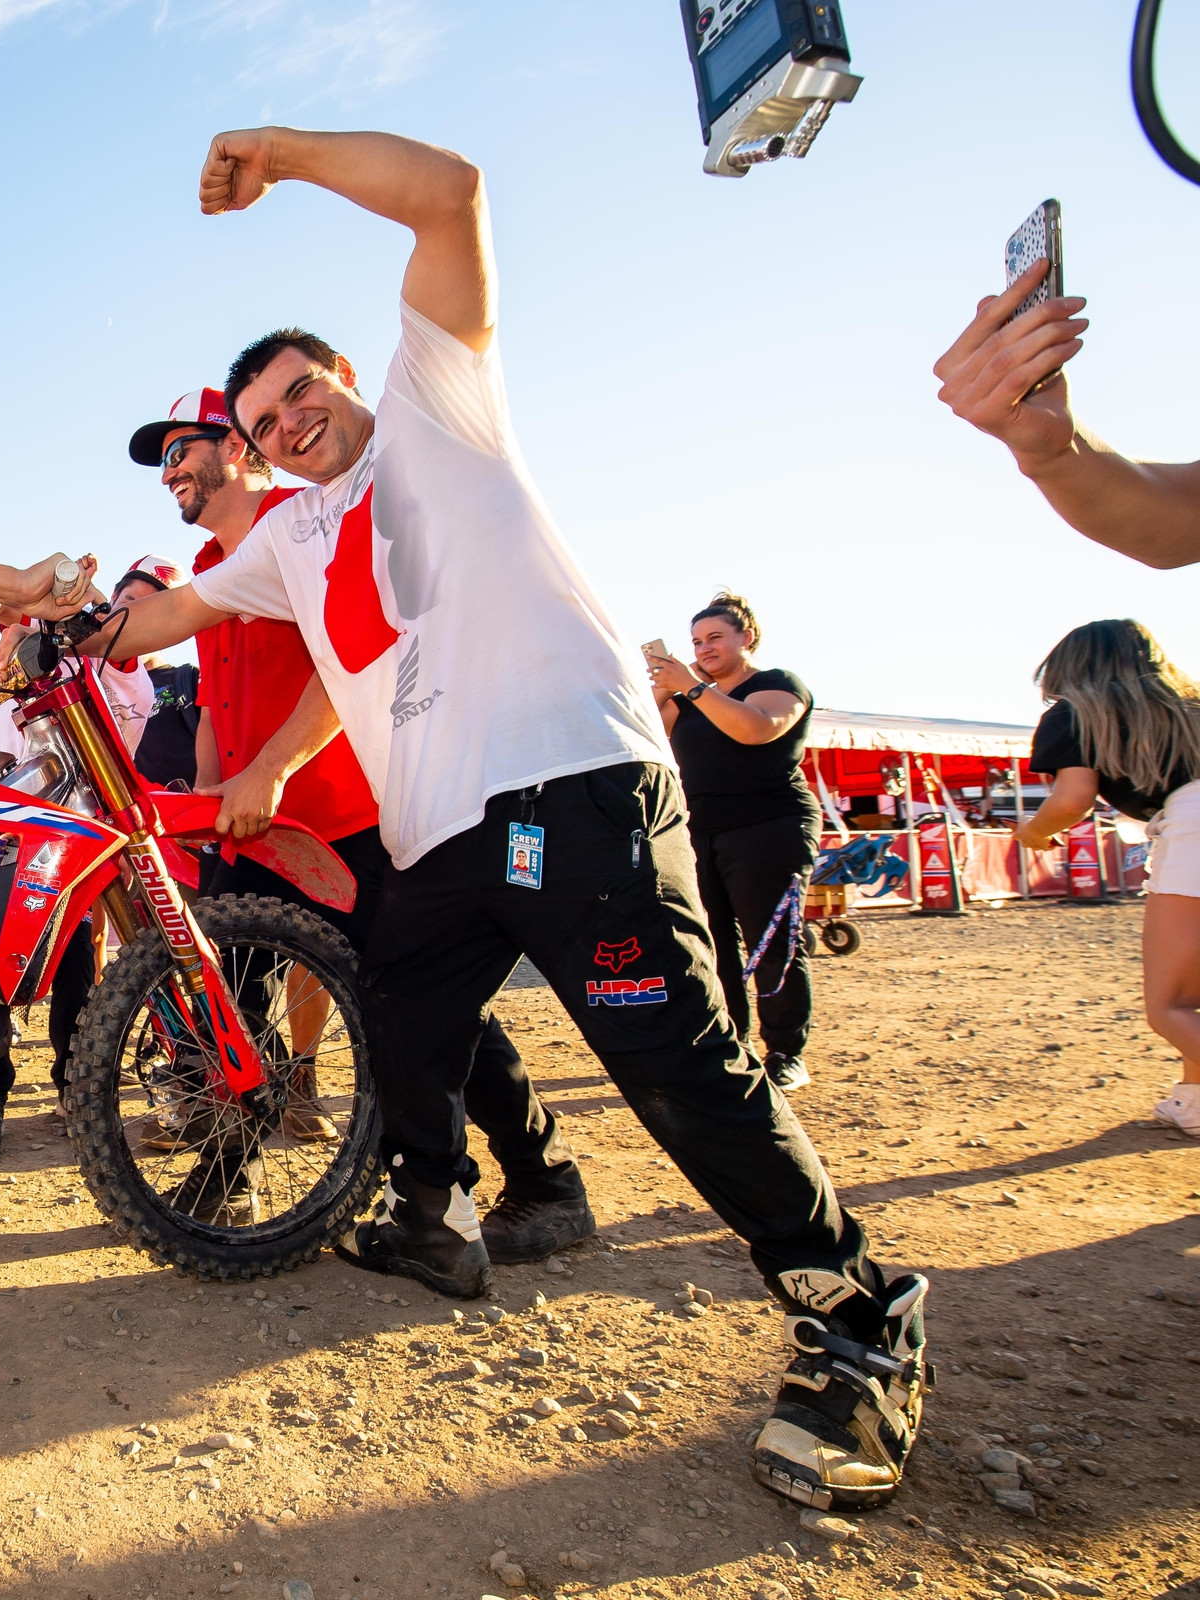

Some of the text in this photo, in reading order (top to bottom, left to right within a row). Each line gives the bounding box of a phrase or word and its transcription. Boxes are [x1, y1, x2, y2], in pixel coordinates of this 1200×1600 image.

[393, 688, 444, 731] ONDA
[513, 834, 539, 846] CREW
[17, 873, 61, 895] HRC
[130, 853, 194, 948] SHOWA
[586, 976, 667, 1006] HRC
[326, 1153, 377, 1230] DUNLOP
